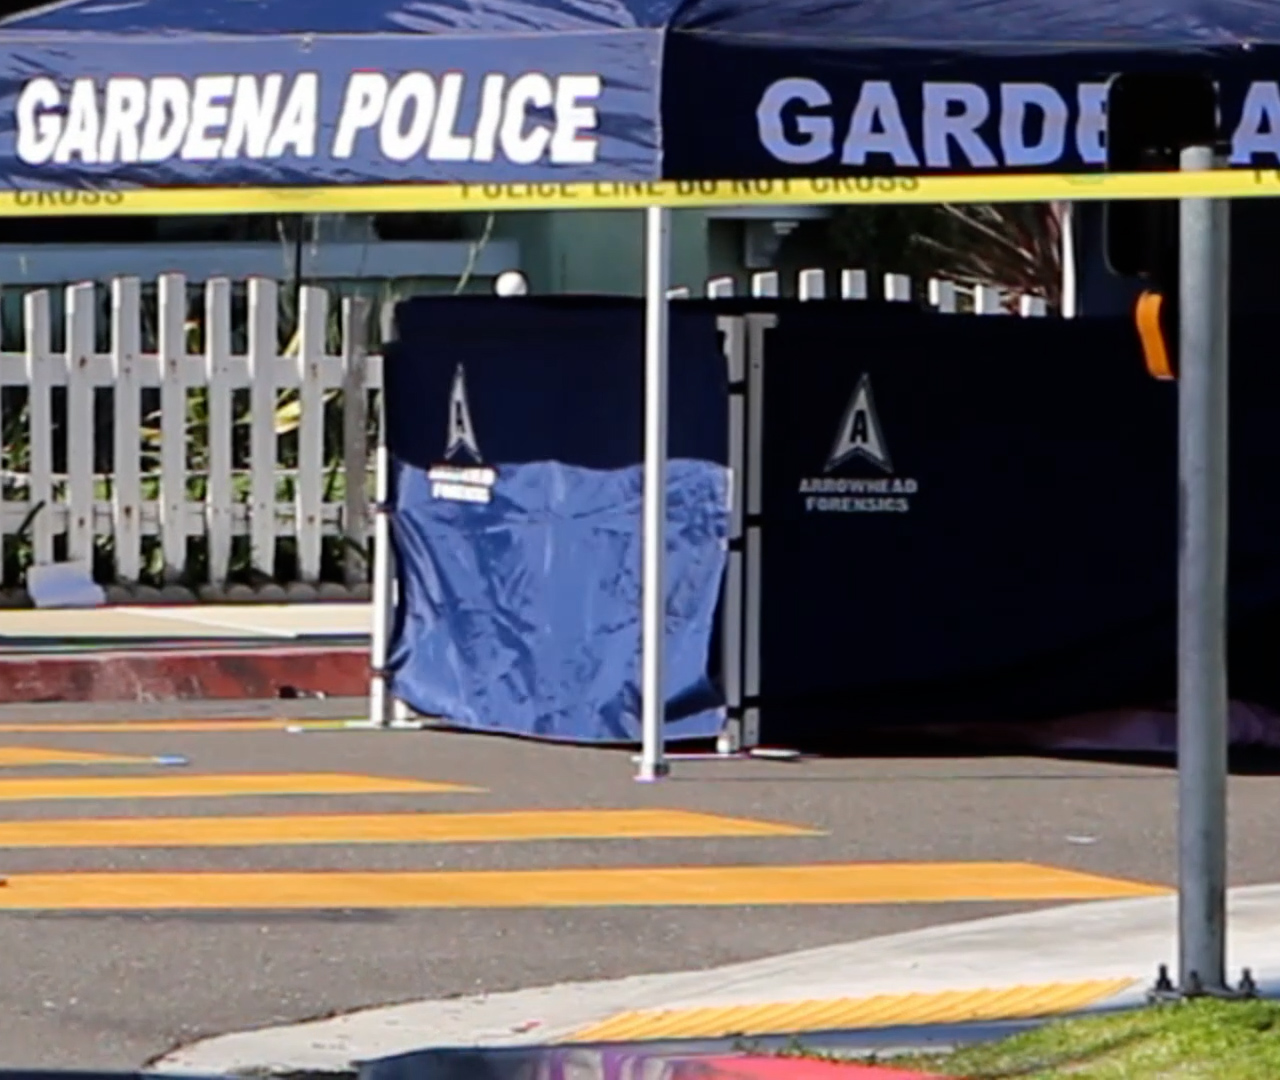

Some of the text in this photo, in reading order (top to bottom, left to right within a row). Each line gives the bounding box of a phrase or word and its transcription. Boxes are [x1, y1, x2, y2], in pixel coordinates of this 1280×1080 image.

[17, 72, 602, 164] GARDENA POLICE
[799, 477, 918, 494] ARROWHEAD
[805, 496, 910, 513] FORENSICS
